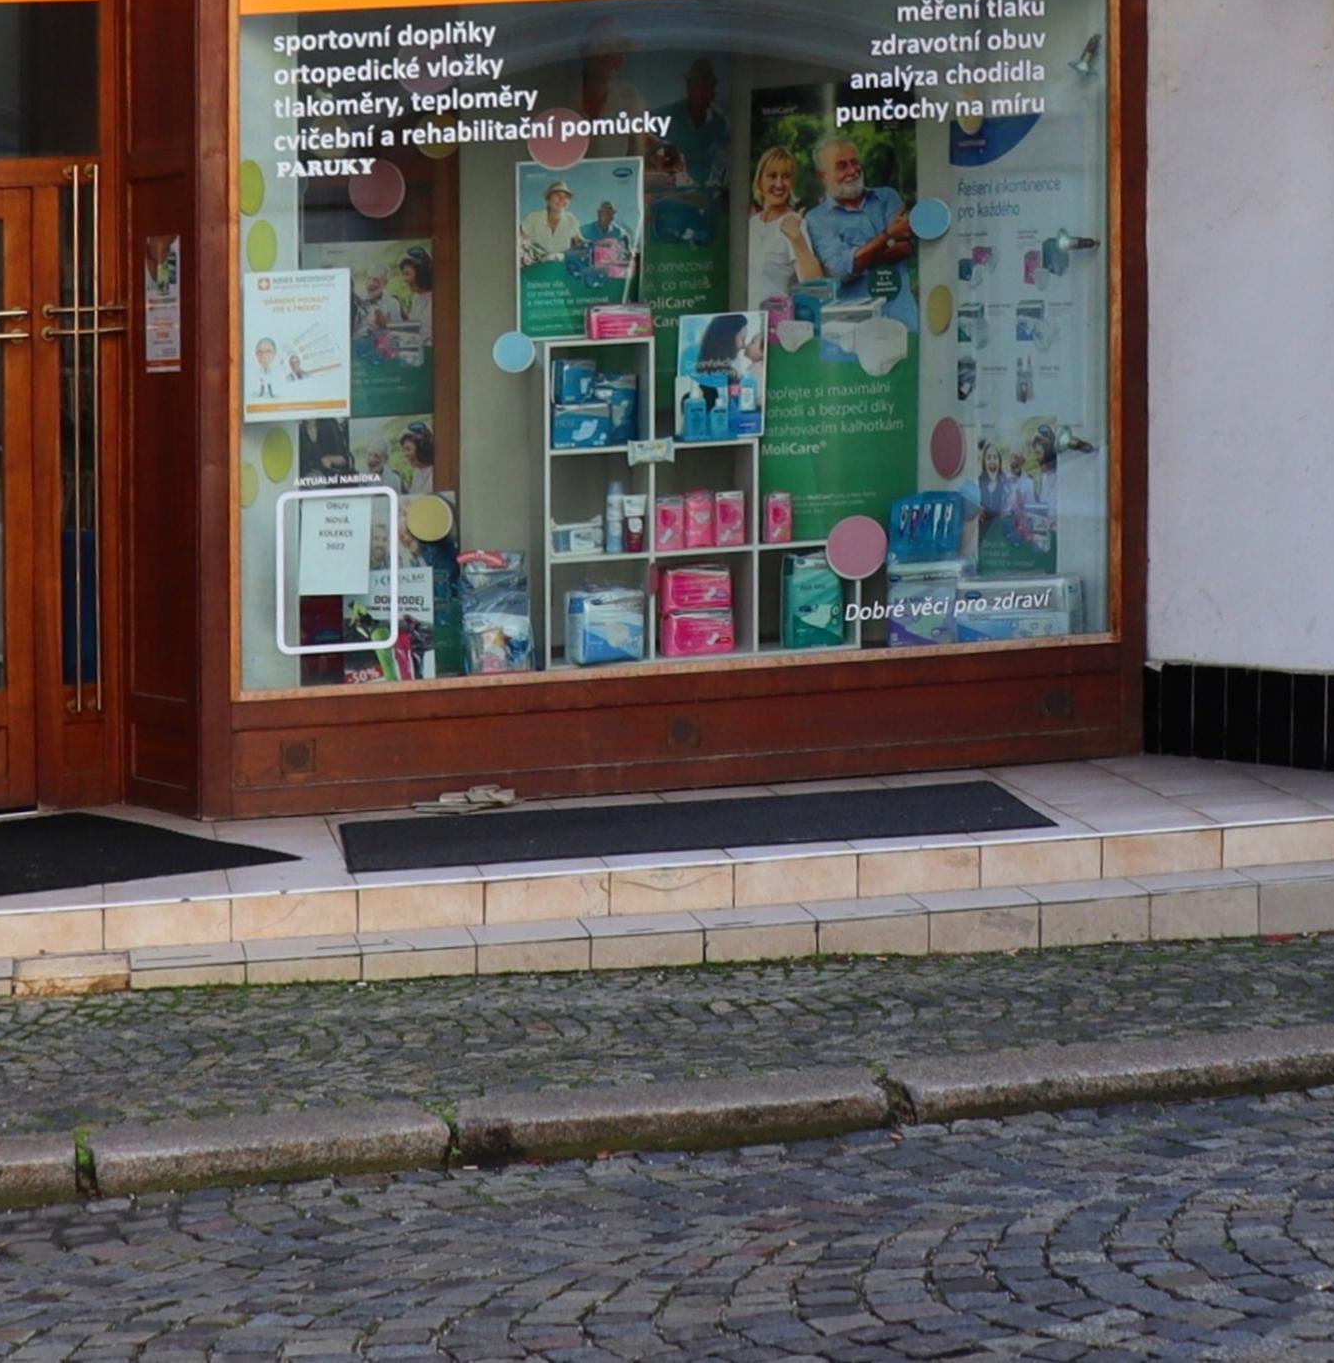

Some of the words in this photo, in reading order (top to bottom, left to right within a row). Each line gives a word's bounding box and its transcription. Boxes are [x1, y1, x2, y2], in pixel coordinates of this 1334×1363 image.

[274, 24, 392, 57] sportovní
[397, 20, 496, 51] doplňky
[870, 31, 981, 57] zdravotní
[988, 30, 1046, 52] obuv
[274, 56, 420, 88] ortopedické
[426, 54, 504, 82] vložky
[850, 66, 939, 93] analýza
[946, 61, 1045, 85] chodidla
[274, 88, 404, 119] tlakoměry,
[411, 85, 539, 114] teploměry
[836, 98, 949, 128] punčochy
[955, 98, 984, 117] na
[992, 93, 1046, 116] míru
[274, 122, 373, 152] cvičební
[381, 130, 395, 147] a
[402, 116, 555, 147] rehabilitační
[561, 110, 671, 142] pomůcky
[276, 157, 378, 179] PARUKY
[957, 205, 976, 221] pro
[767, 403, 804, 418] ohodlí
[766, 421, 838, 438] atahovacím
[845, 600, 905, 622] Dobré
[910, 596, 950, 617] věci
[953, 597, 987, 616] pro
[993, 589, 1051, 611] zdraví
